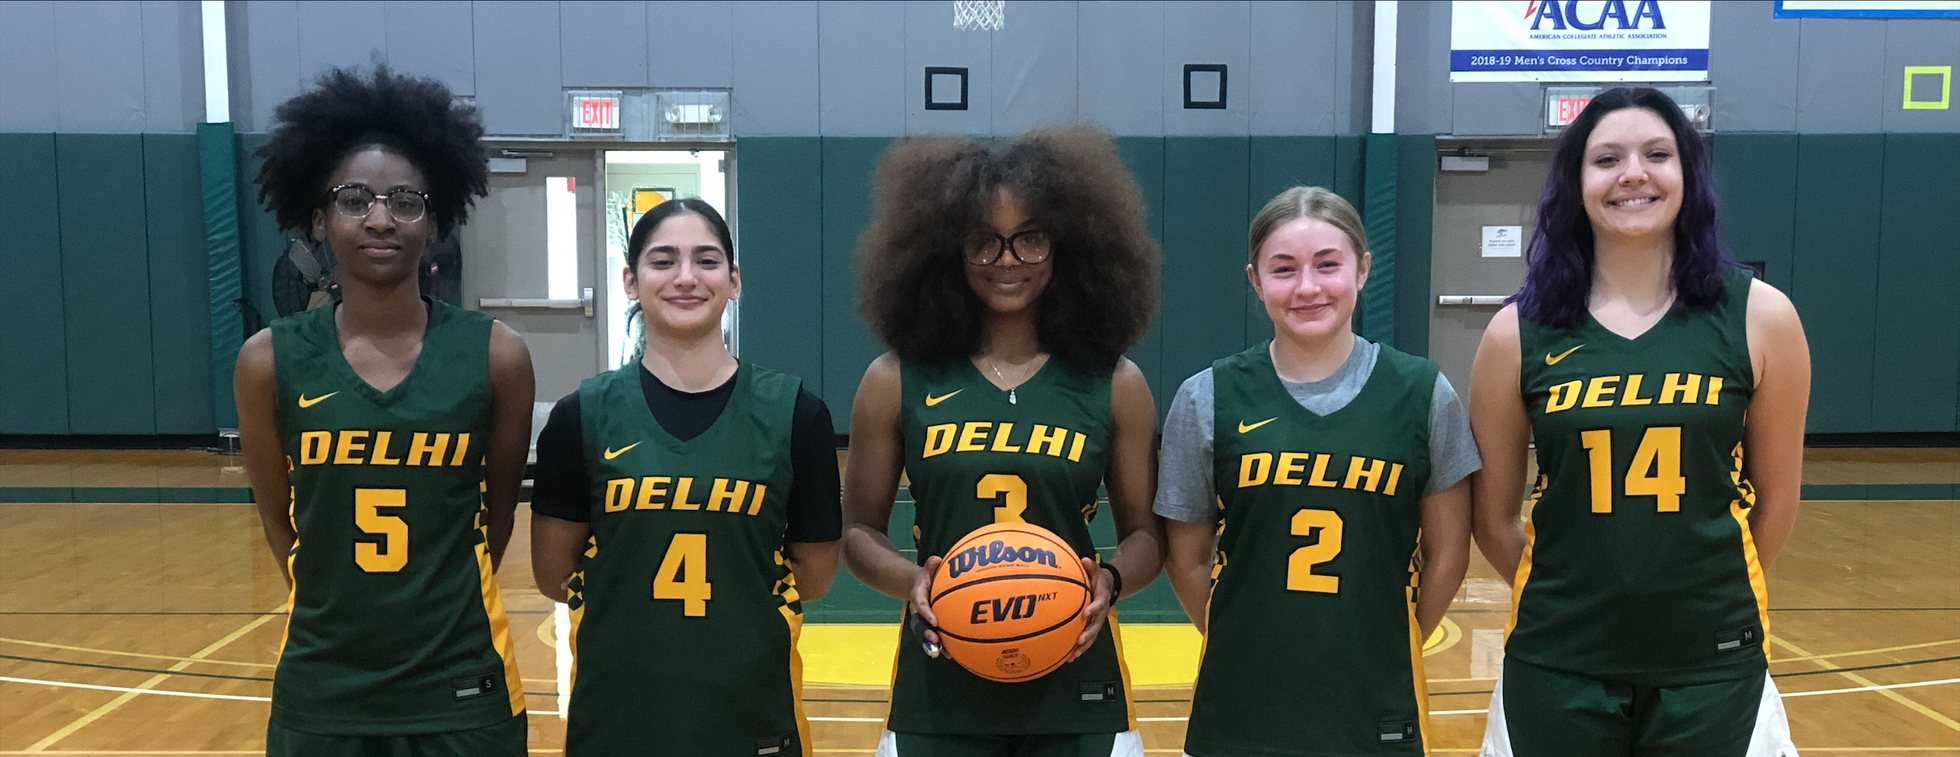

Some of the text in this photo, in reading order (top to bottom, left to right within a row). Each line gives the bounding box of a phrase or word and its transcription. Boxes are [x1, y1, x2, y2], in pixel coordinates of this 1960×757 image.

[1530, 1, 1667, 30] ACAA
[1470, 55, 1689, 67] 2018-19 Men's Cross Country Champions
[582, 101, 612, 124] EXIT
[1544, 374, 1724, 415] DELHI
[300, 430, 471, 468] DELHI
[923, 421, 1087, 464] DELHI
[1237, 452, 1404, 497] DELHI
[1581, 426, 1687, 515] 14
[604, 477, 768, 516] DELHI
[355, 488, 409, 573] 5
[948, 540, 1058, 578] Wilson
[1286, 508, 1344, 594] 2
[653, 533, 712, 617] 4
[970, 591, 1058, 625] EVO NXT
[485, 679, 492, 688] S
